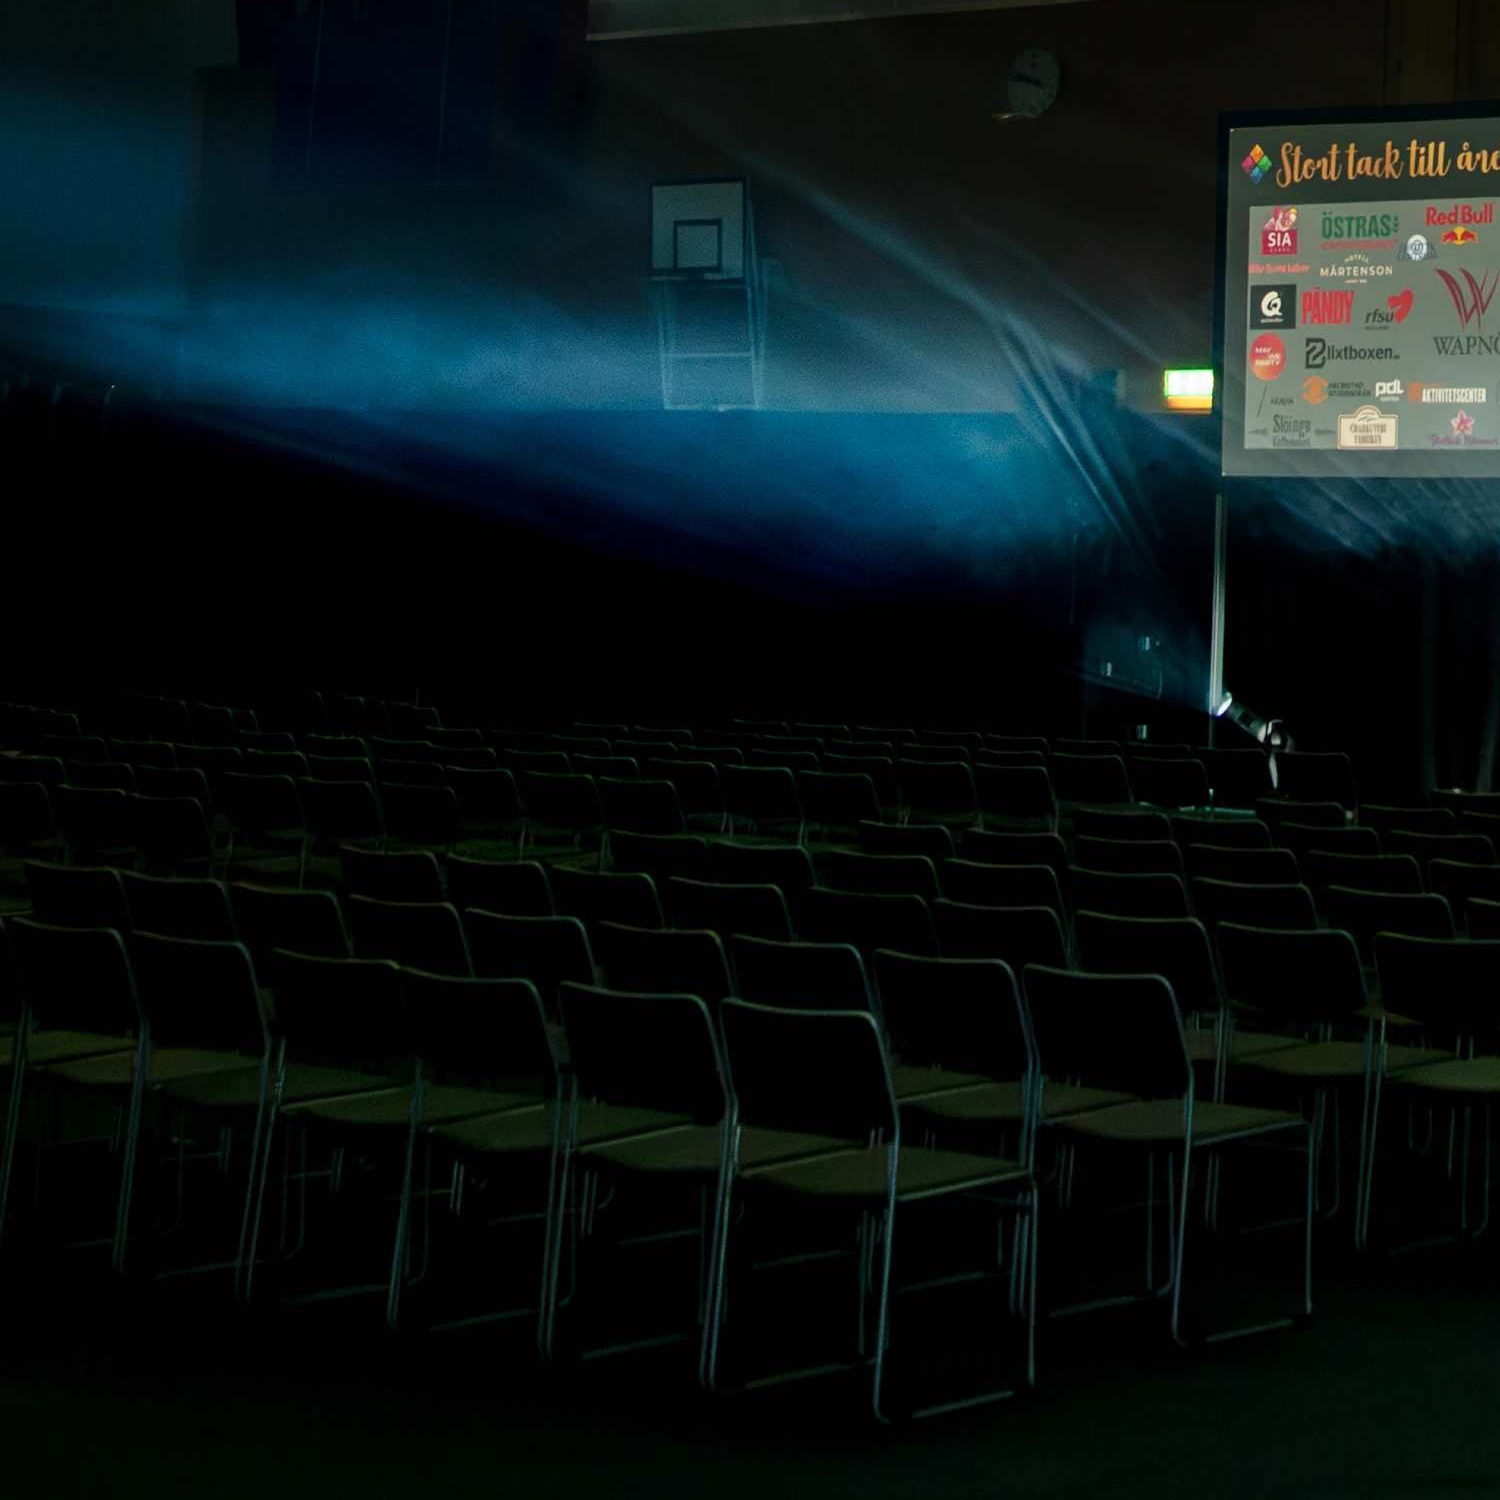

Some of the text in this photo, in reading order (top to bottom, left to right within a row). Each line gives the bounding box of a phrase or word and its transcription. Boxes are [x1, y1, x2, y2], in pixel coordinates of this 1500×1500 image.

[1276, 142, 1342, 188] Stort
[1345, 140, 1404, 180] tack
[1407, 139, 1451, 177] till
[1425, 202, 1493, 226] Red Bull
[1321, 211, 1391, 239] ÖSTRAS
[1267, 232, 1292, 248] SIA
[1319, 264, 1393, 277] MÅRTENSON
[1365, 308, 1394, 324] rfsu
[1422, 387, 1487, 403] AKTIVITETSCENTER
